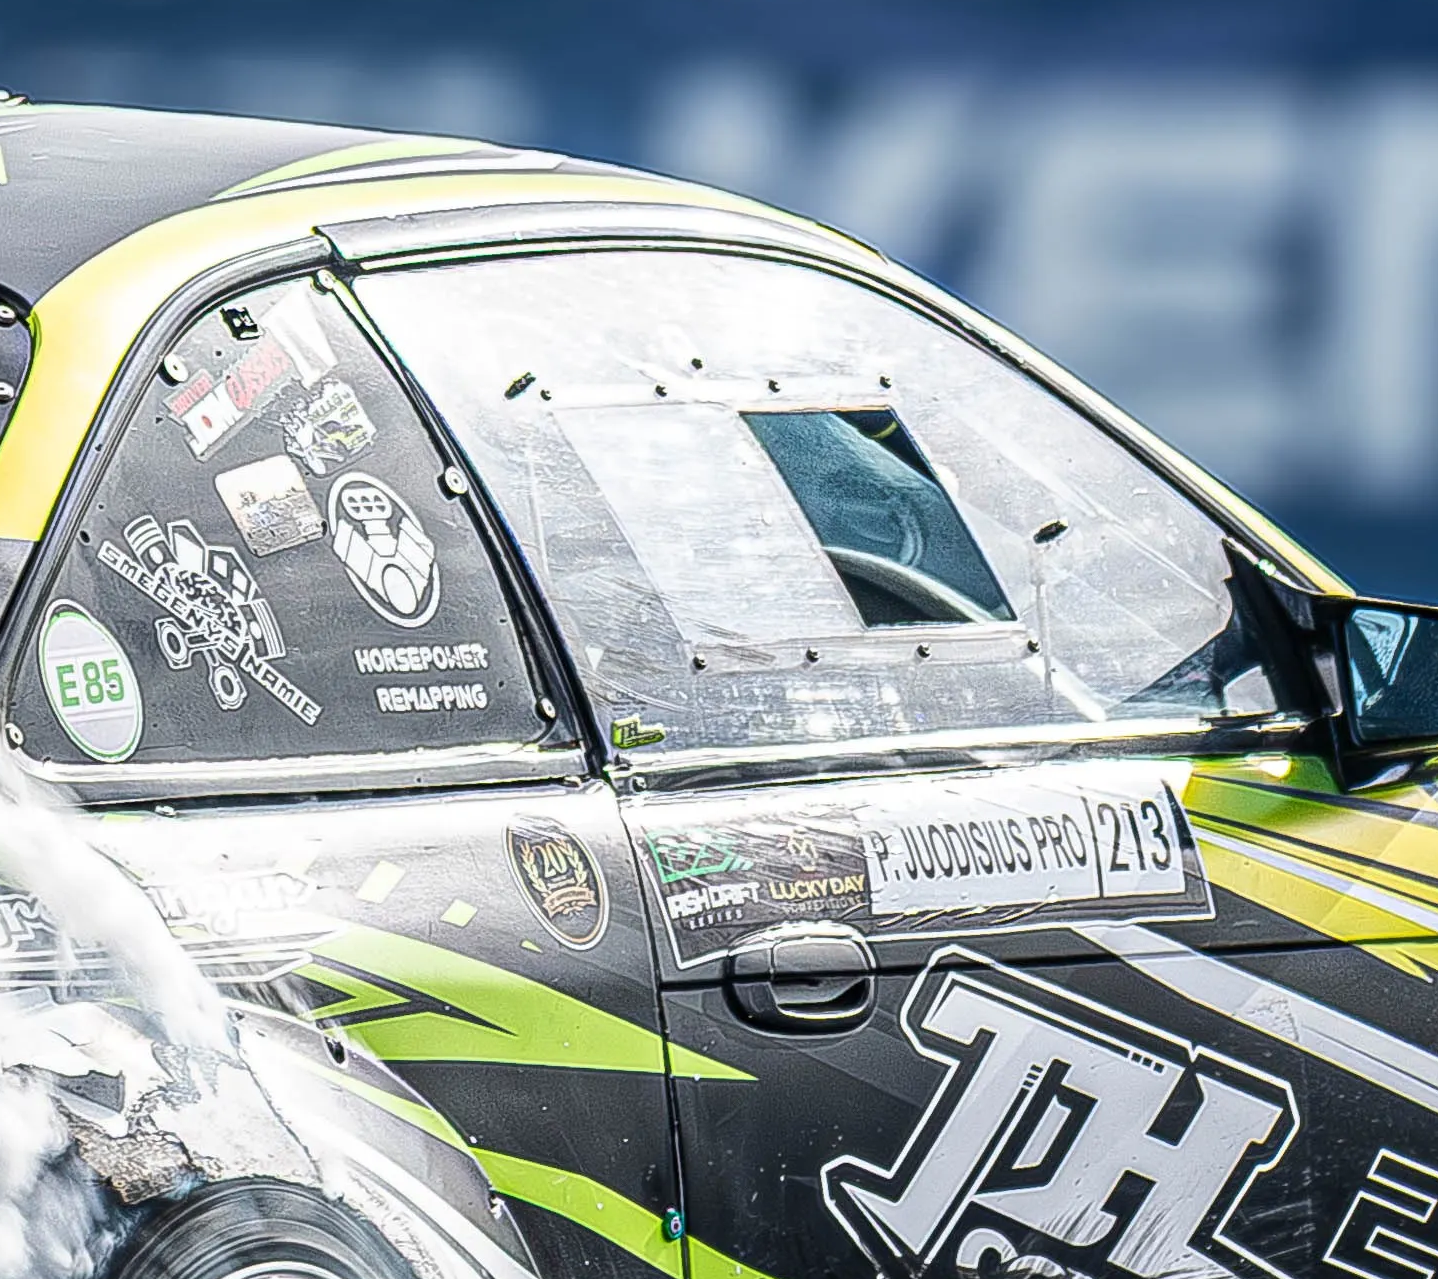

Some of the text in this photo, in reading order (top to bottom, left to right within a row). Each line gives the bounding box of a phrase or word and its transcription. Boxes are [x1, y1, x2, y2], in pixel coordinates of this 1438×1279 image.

[353, 642, 490, 674] HORSEPOWER
[374, 682, 489, 714] REMAPPING
[899, 817, 1032, 881] JUODISIUS
[1028, 812, 1088, 871] PRO
[1097, 799, 1173, 874] 213
[768, 873, 866, 902] LUCKY DAY
